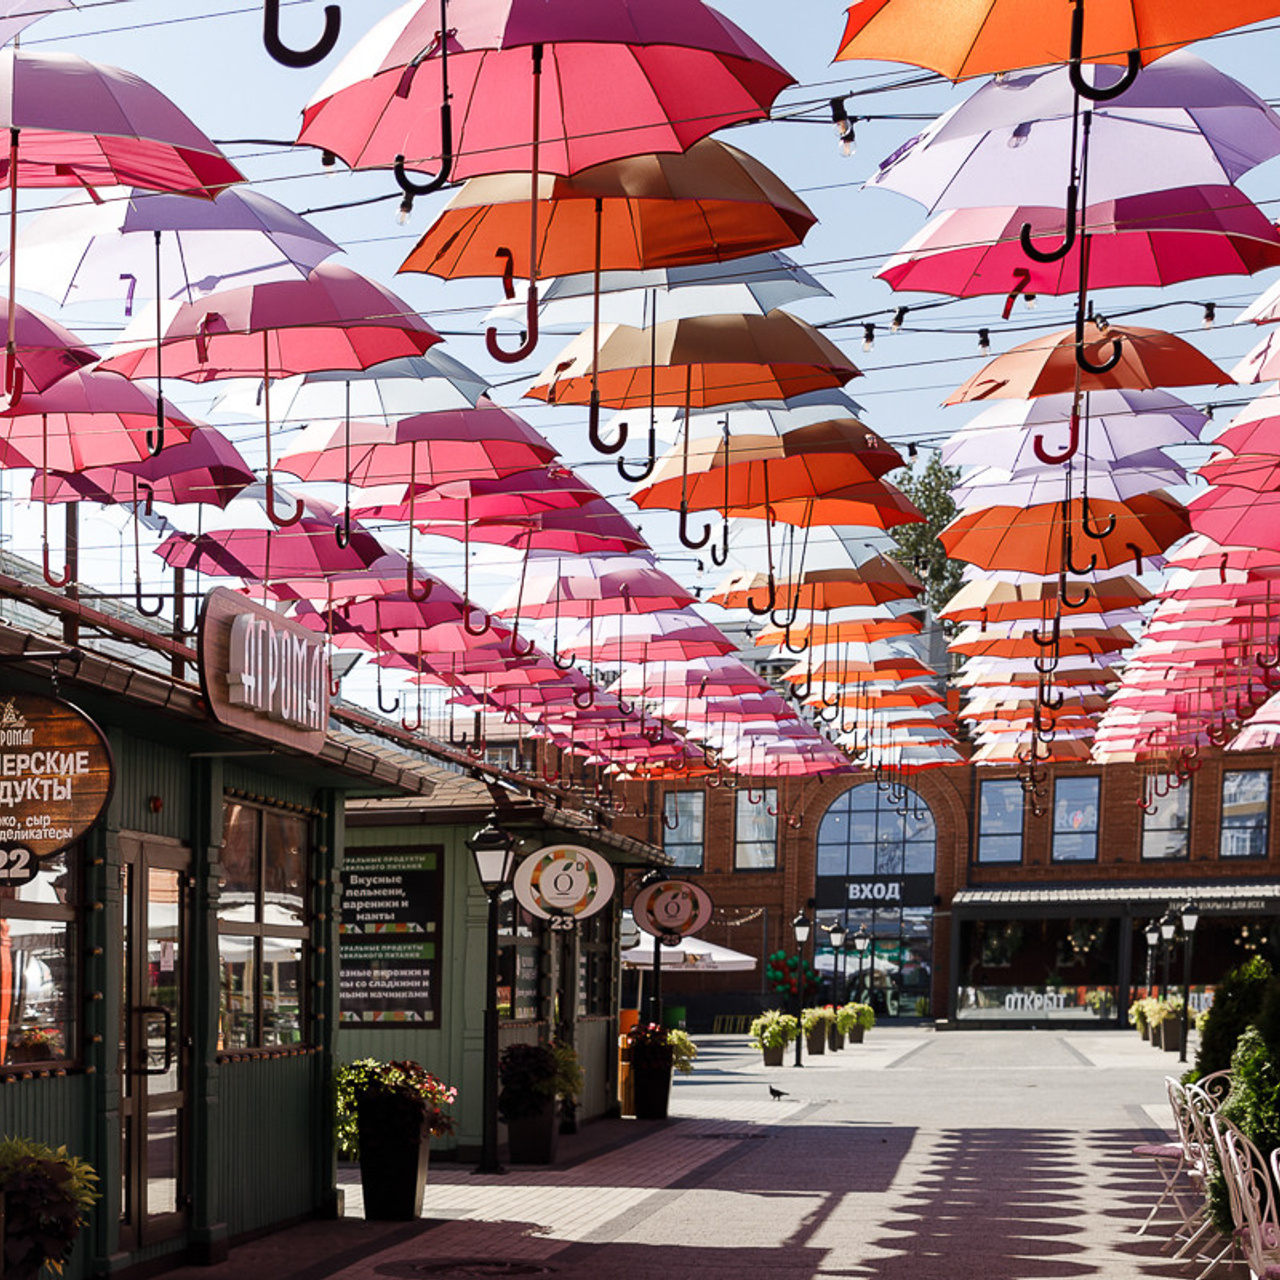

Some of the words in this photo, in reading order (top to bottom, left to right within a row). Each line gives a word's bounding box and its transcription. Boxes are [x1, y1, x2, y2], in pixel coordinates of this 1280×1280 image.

[234, 614, 330, 732] АГРОМАГ
[25, 814, 51, 829] сыр
[349, 874, 403, 887] Вкусные
[345, 887, 407, 898] пельмени,
[848, 882, 901, 901] ВХОД
[342, 900, 400, 911] вареники
[401, 900, 410, 909] и
[356, 911, 396, 921] манты
[550, 915, 575, 931] 23
[372, 969, 422, 979] пирожки
[422, 969, 431, 977] и
[354, 980, 368, 988] со
[368, 979, 422, 989] сладкими
[422, 979, 430, 987] и
[369, 990, 429, 999] начинками
